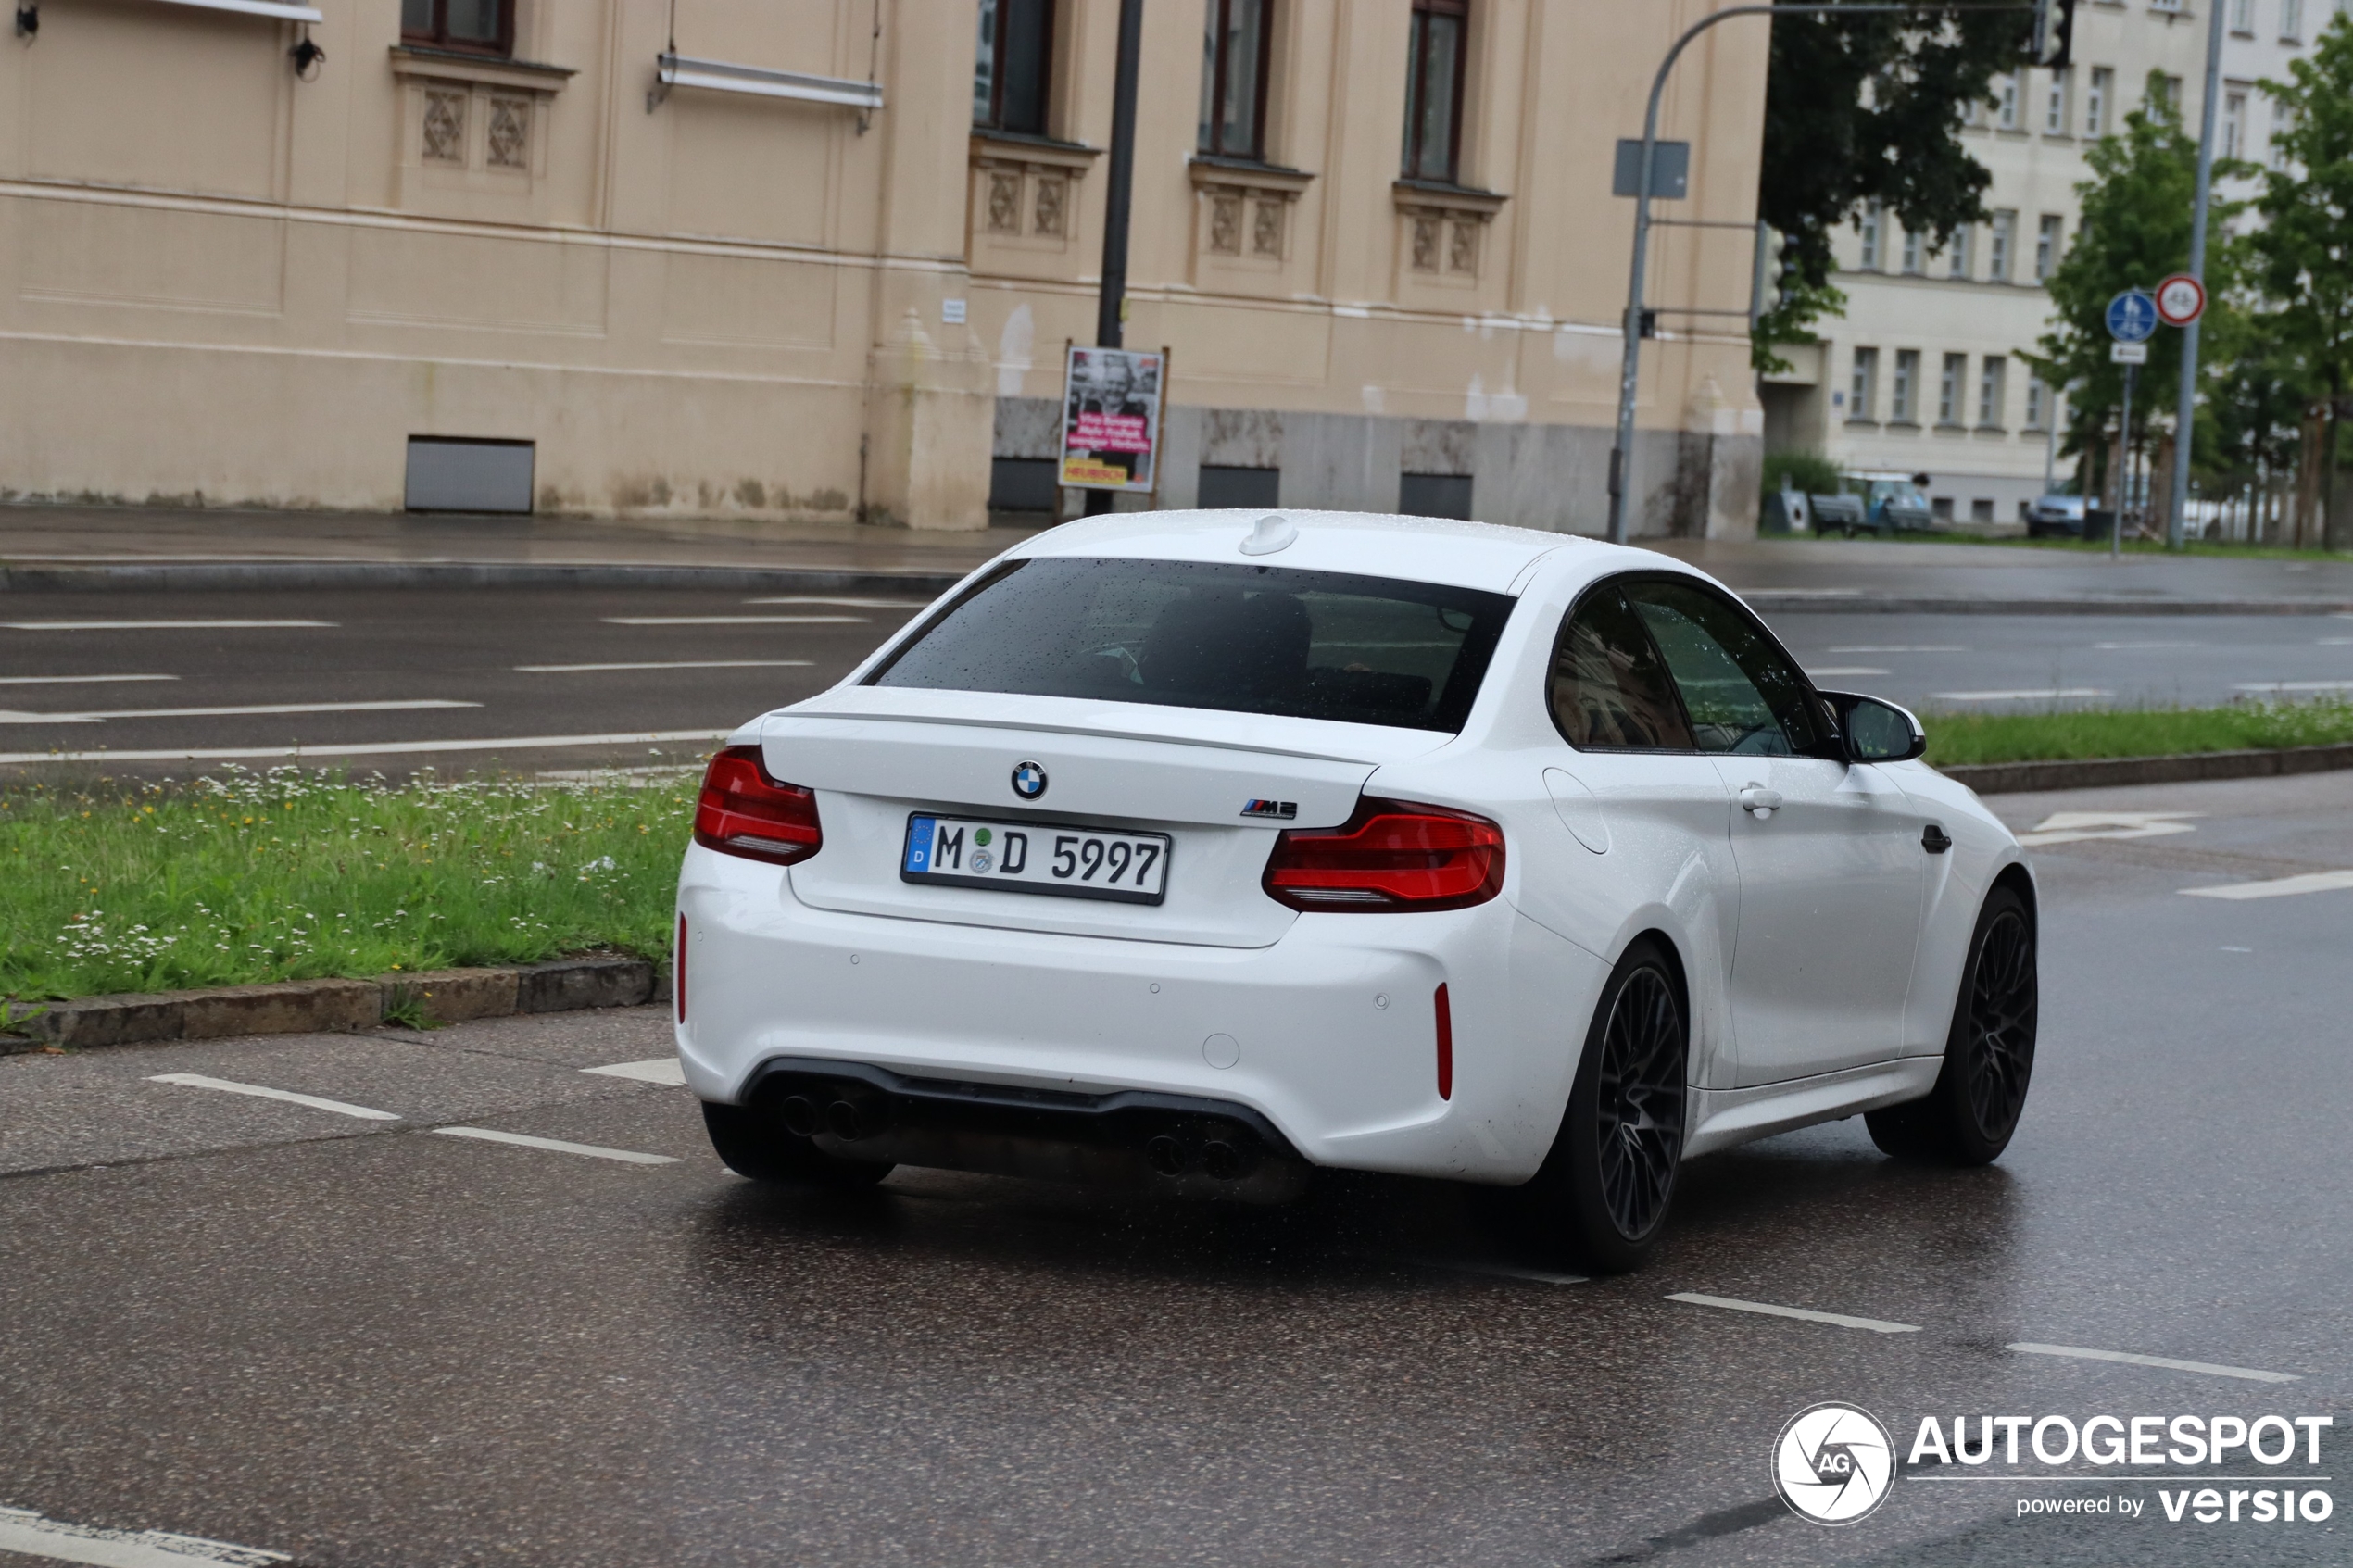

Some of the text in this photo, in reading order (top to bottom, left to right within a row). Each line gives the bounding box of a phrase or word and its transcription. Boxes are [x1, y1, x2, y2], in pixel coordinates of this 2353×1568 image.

[1256, 799, 1297, 814] M2
[913, 850, 925, 863] D
[934, 825, 1162, 886] M D 5997
